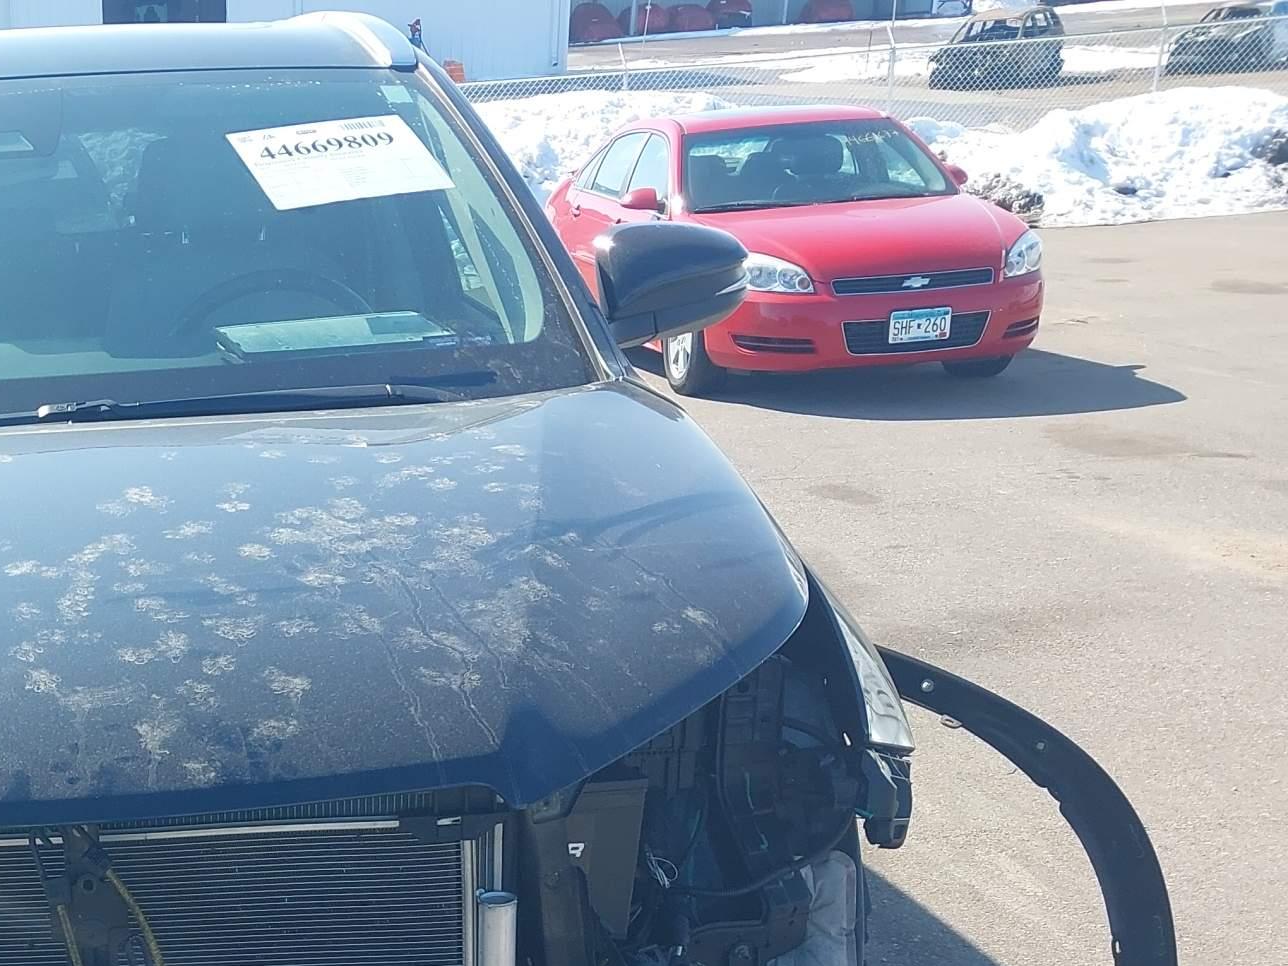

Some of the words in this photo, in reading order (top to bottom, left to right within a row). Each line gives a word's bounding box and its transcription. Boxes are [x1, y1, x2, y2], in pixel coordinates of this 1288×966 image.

[260, 131, 394, 160] 44669809
[893, 319, 916, 336] SHF
[924, 316, 947, 334] 260
